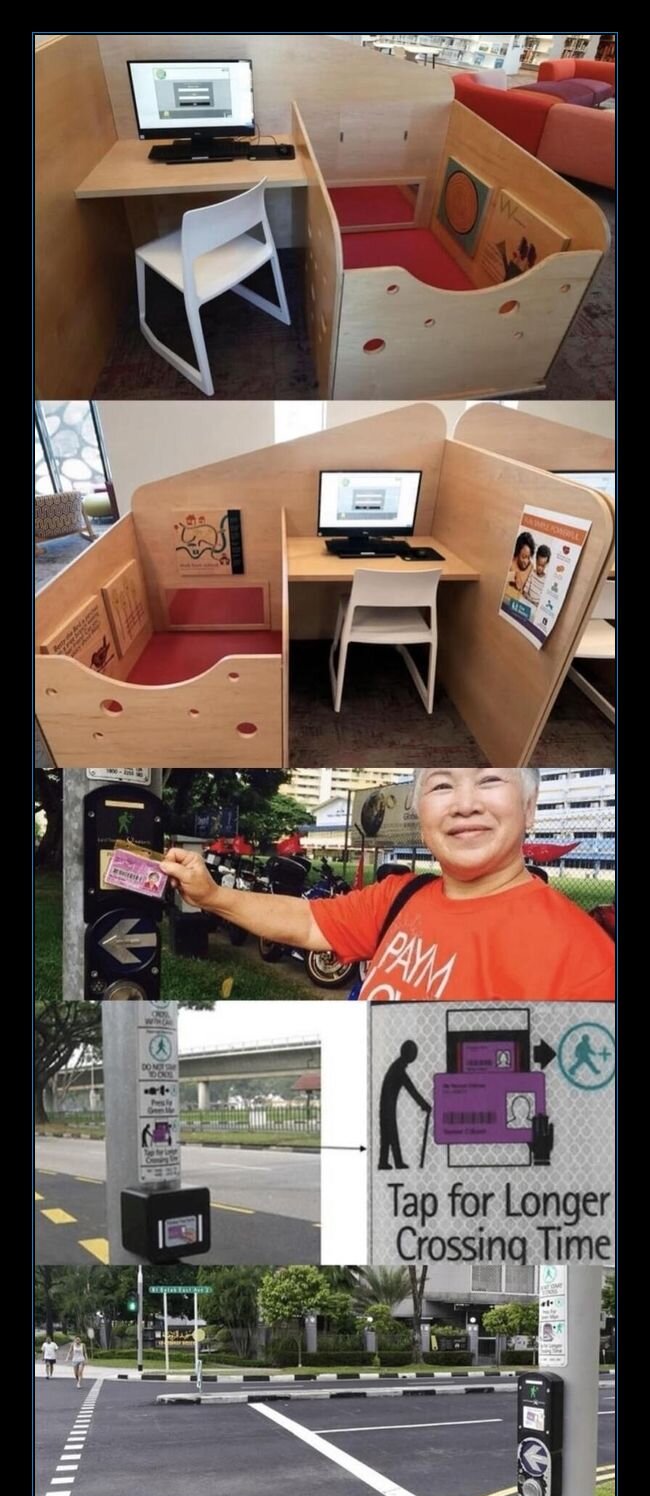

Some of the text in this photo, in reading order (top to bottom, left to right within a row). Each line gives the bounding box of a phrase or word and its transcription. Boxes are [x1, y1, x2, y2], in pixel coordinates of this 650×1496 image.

[387, 1182, 611, 1227] Tap for Longer
[396, 1226, 611, 1265] Crossing Time
